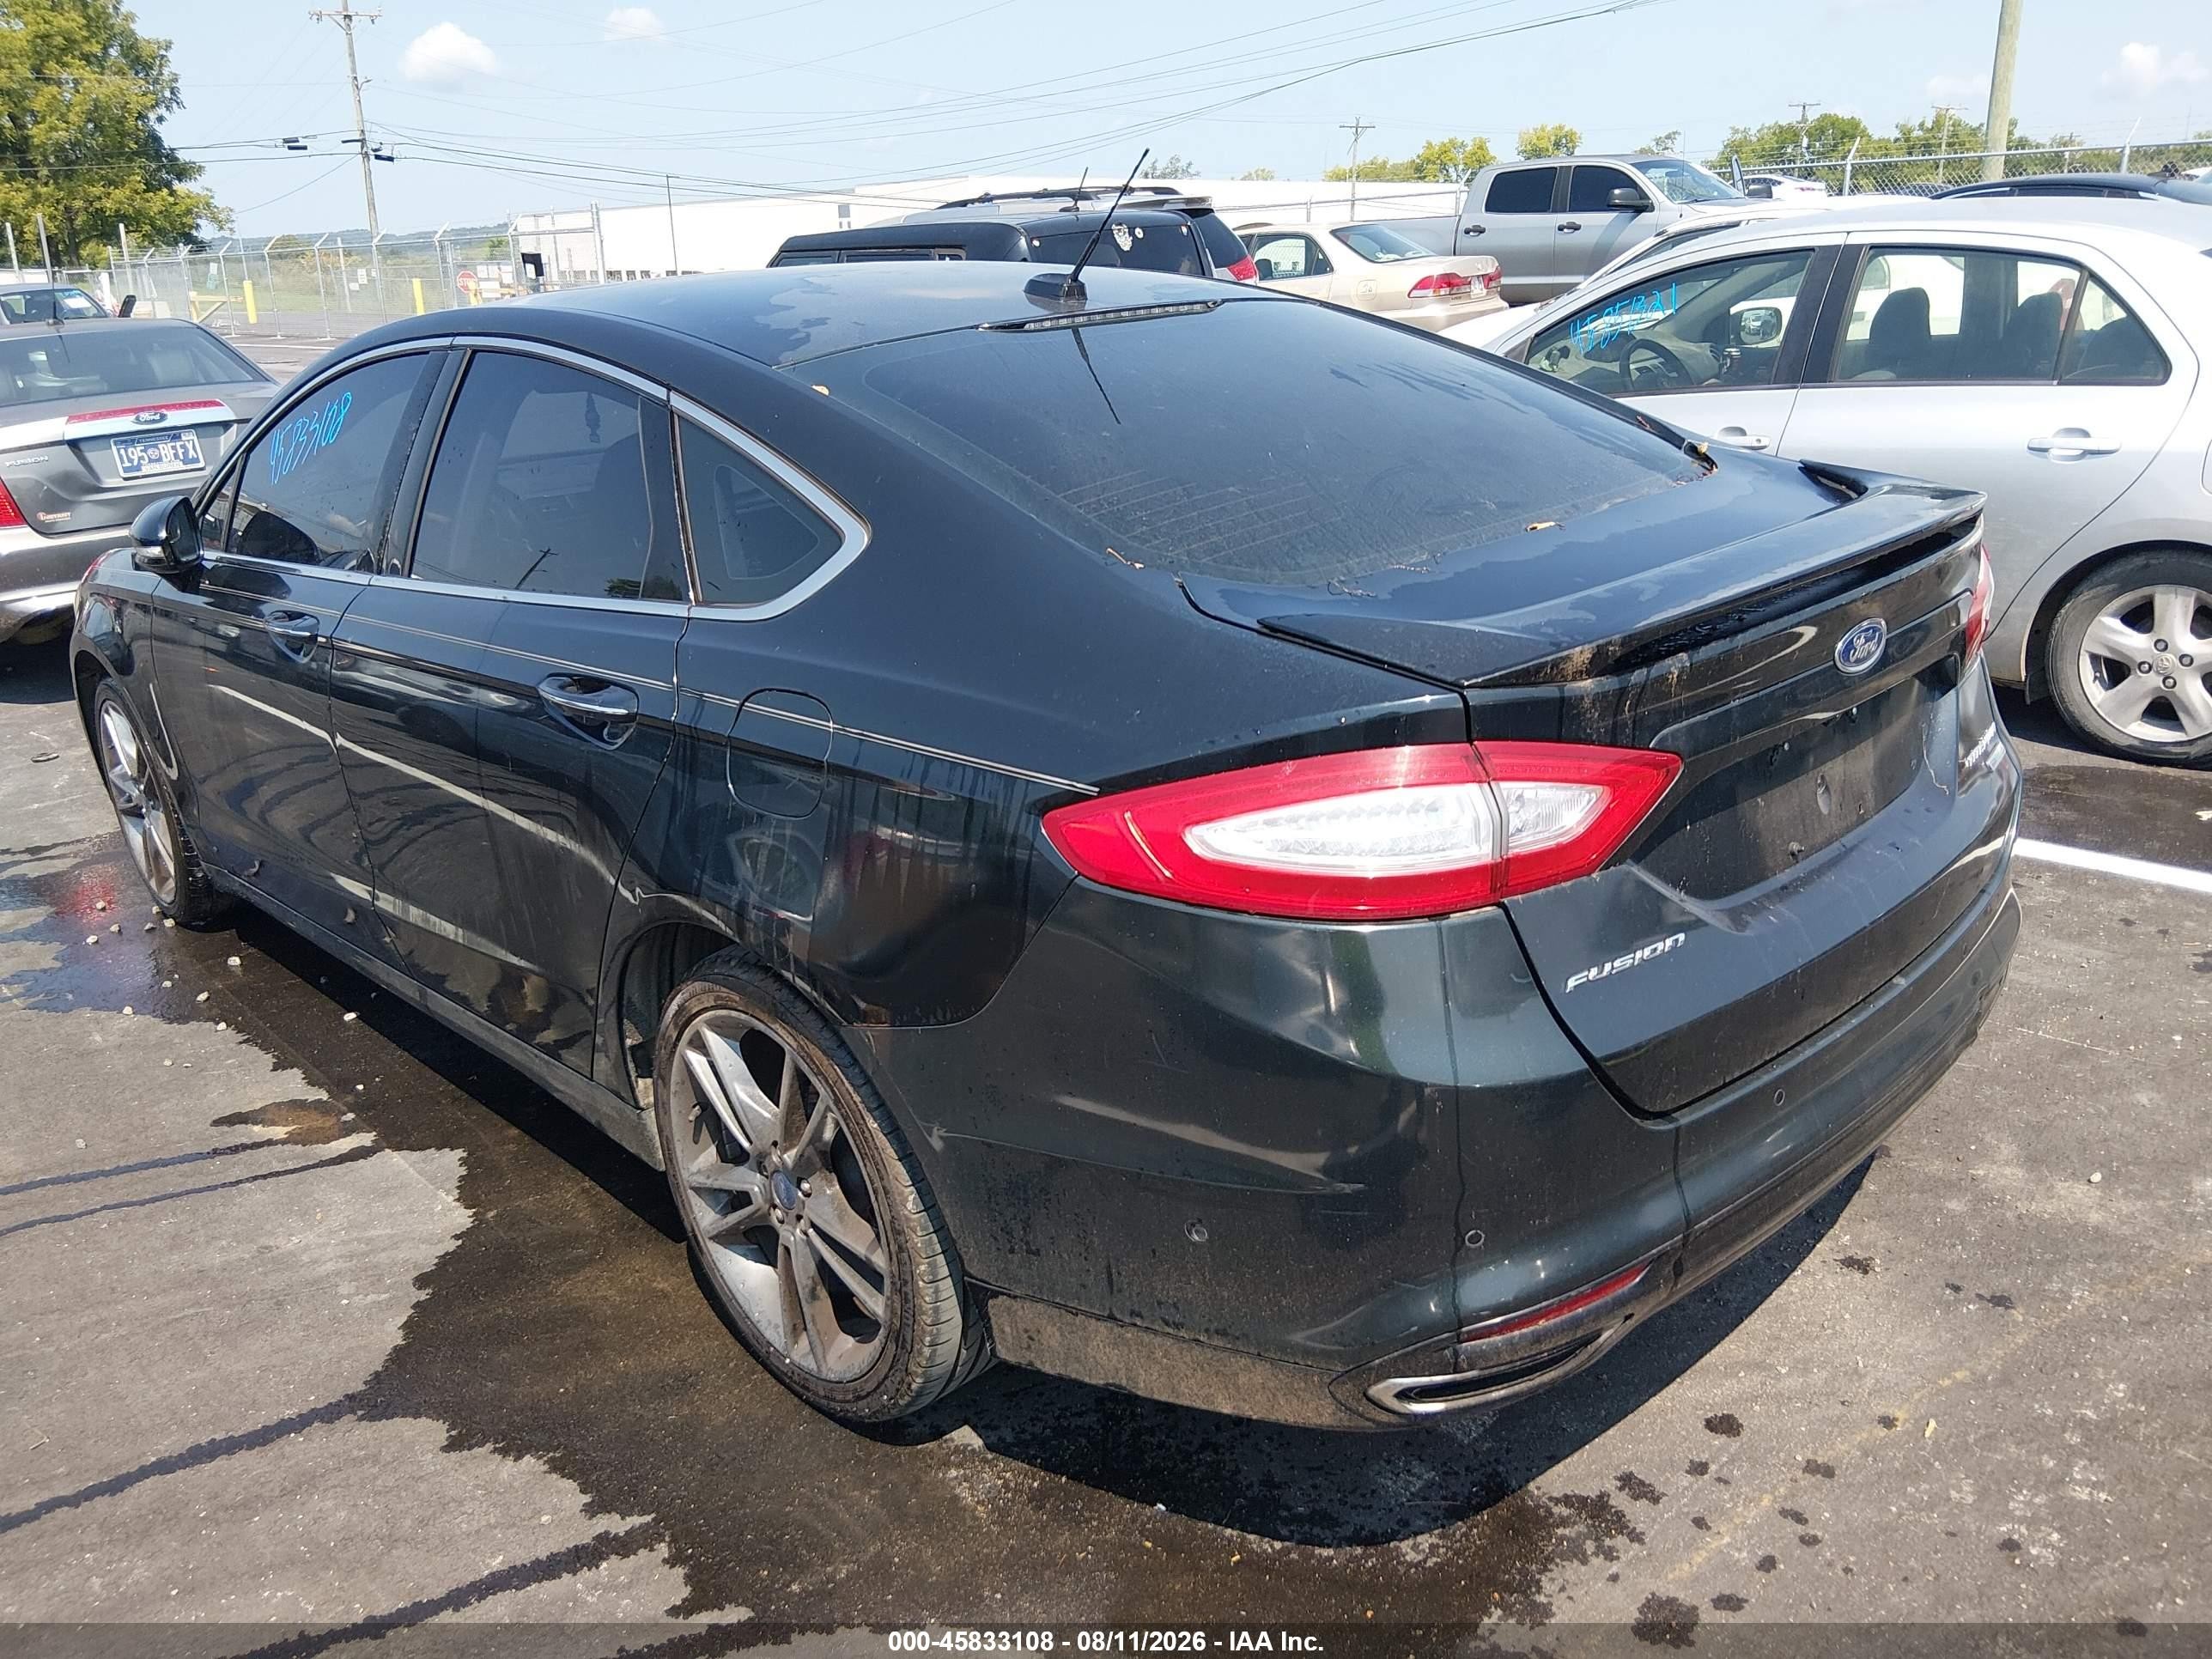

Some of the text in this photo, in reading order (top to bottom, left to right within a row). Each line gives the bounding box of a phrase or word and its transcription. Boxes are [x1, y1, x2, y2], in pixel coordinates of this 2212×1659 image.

[139, 412, 161, 422] Ford
[270, 392, 352, 485] 45833108
[5, 455, 49, 467] FUSION
[119, 447, 149, 467] 195
[1850, 629, 1879, 663] Ford
[1565, 932, 1686, 994] FUSION
